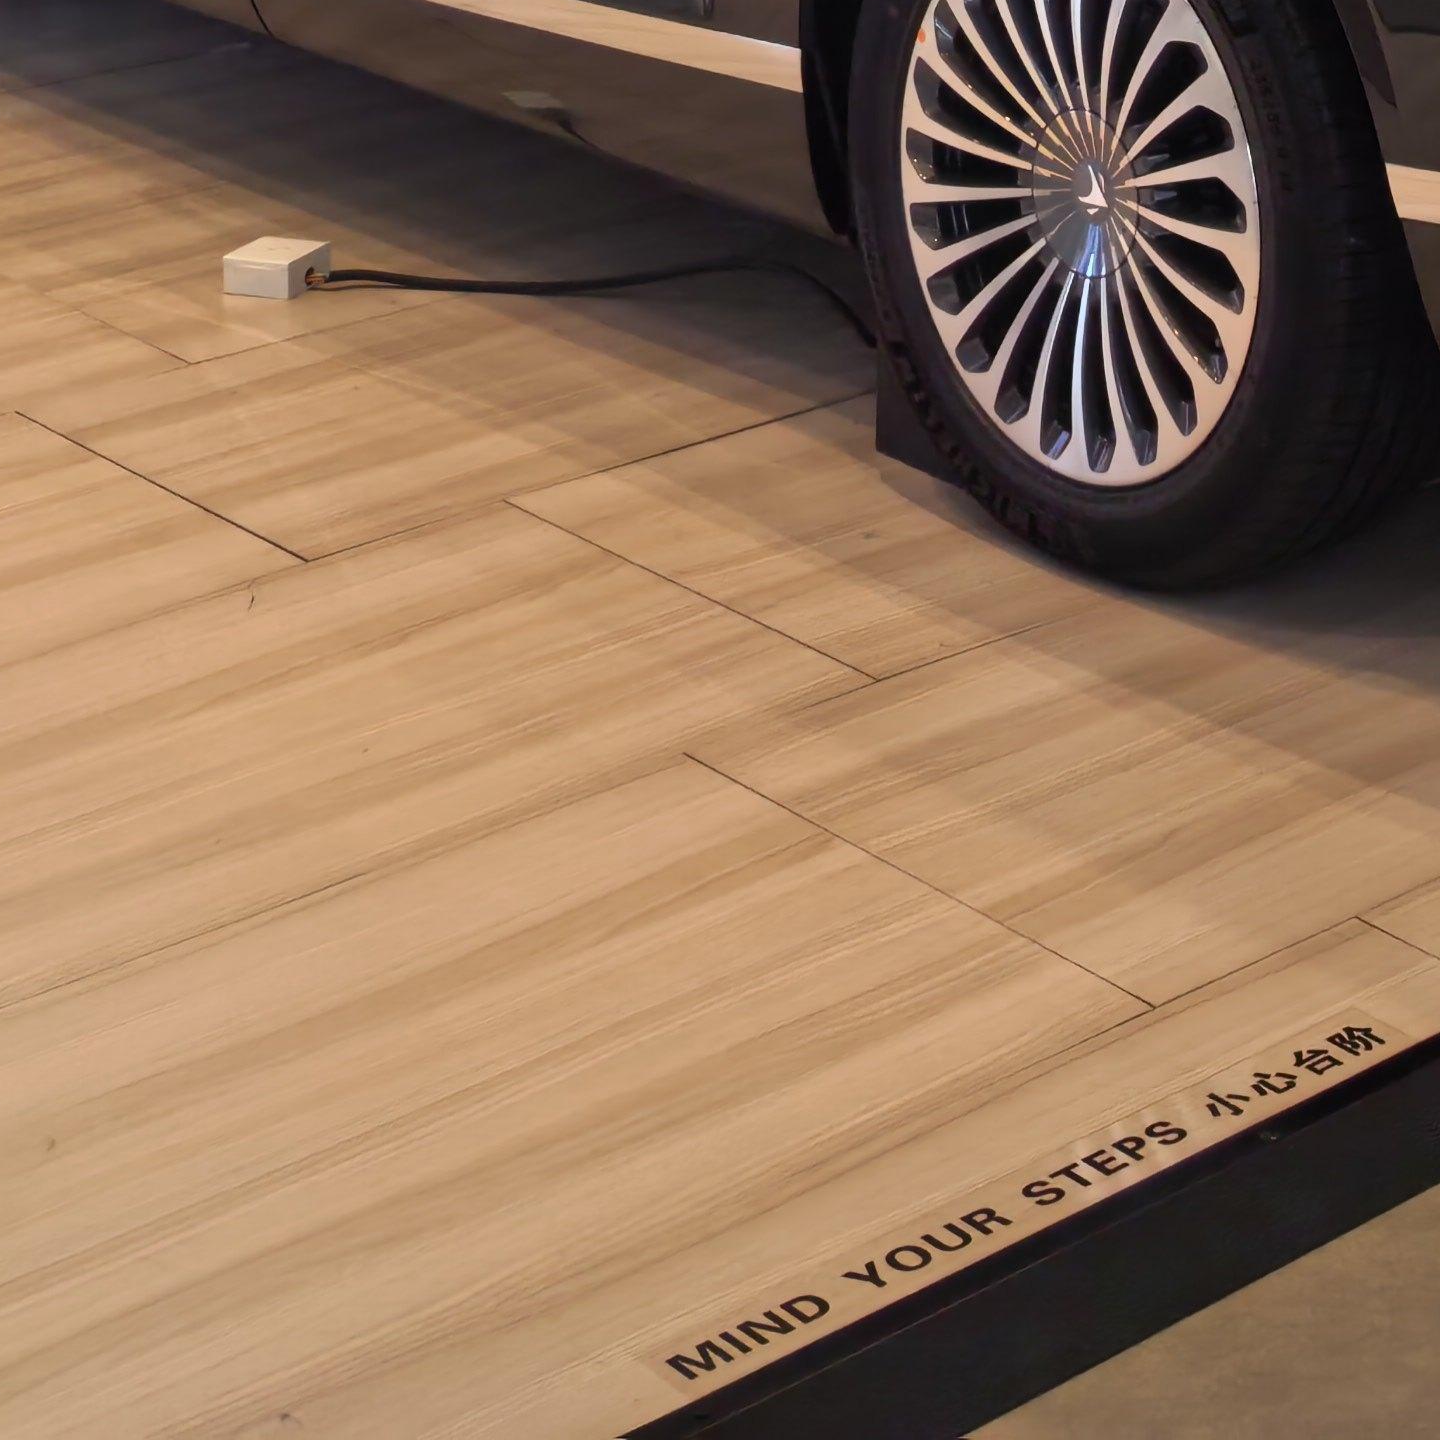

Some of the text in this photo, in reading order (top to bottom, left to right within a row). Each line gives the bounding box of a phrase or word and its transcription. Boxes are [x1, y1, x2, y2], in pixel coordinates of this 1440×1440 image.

[664, 1021, 1389, 1384] MIND YOUR STEPS 小心台阶
